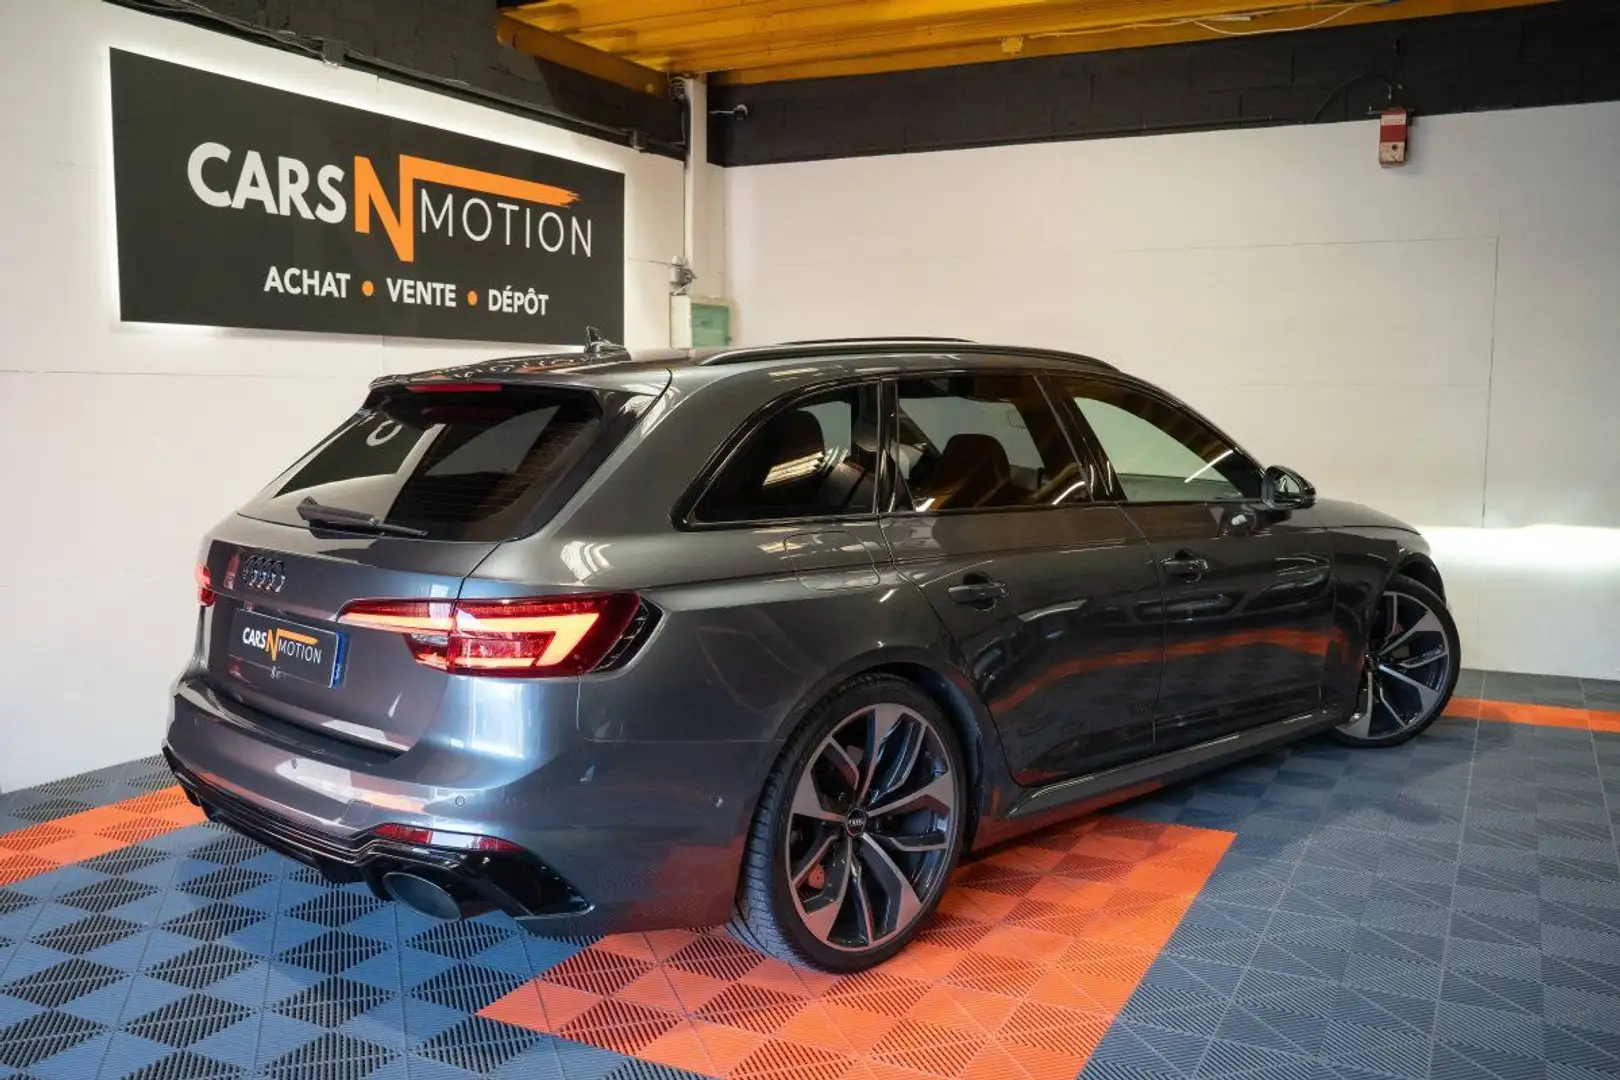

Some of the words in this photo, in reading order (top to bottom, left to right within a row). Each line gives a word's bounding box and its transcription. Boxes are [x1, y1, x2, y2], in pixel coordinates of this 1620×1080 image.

[187, 141, 347, 224] CARS
[421, 188, 592, 258] MOTION
[263, 265, 351, 298] ACHAT
[386, 277, 457, 307] VENTE
[487, 285, 549, 316] DÉPÔT
[242, 627, 266, 649] CARS
[279, 638, 322, 664] MOTION
